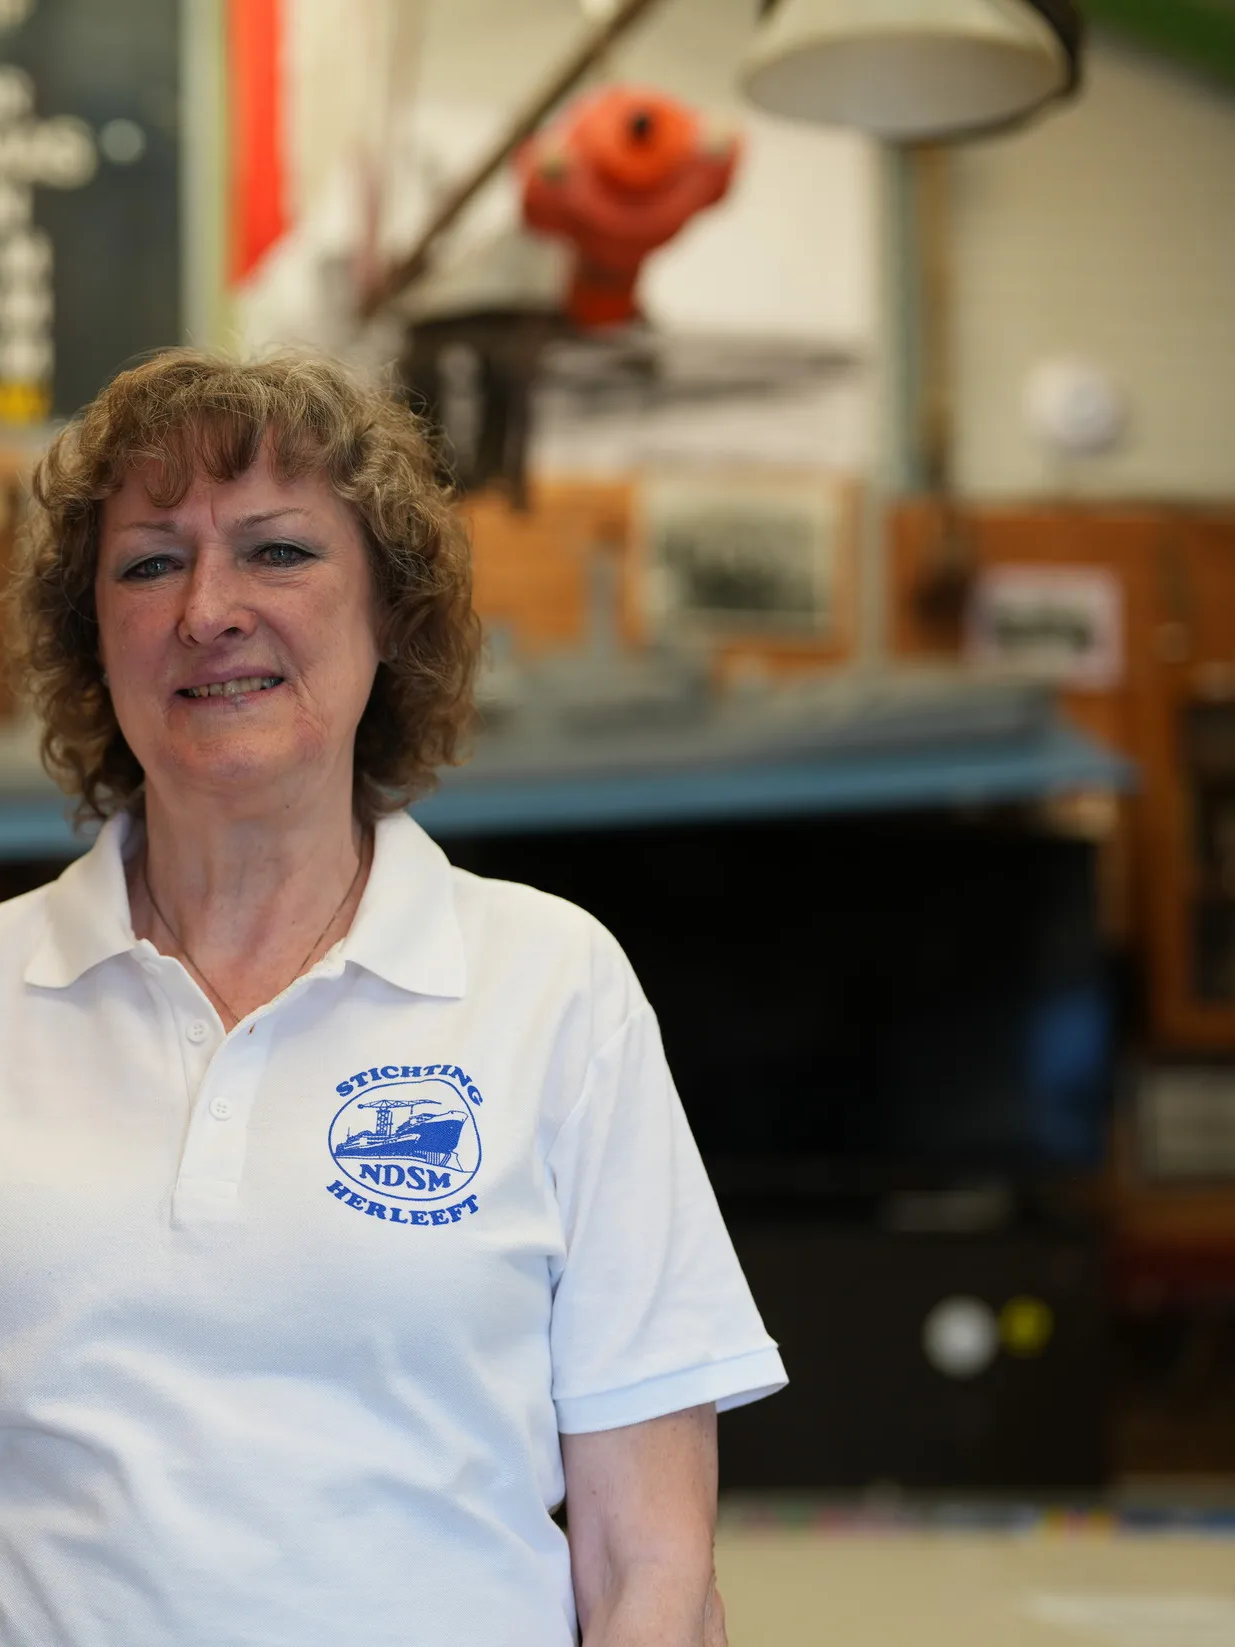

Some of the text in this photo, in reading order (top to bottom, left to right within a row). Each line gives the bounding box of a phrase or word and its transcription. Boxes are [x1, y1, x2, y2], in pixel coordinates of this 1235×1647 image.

[335, 1064, 483, 1106] STICHTING
[359, 1163, 451, 1192] NDSM
[326, 1179, 479, 1226] HERLEEFT
